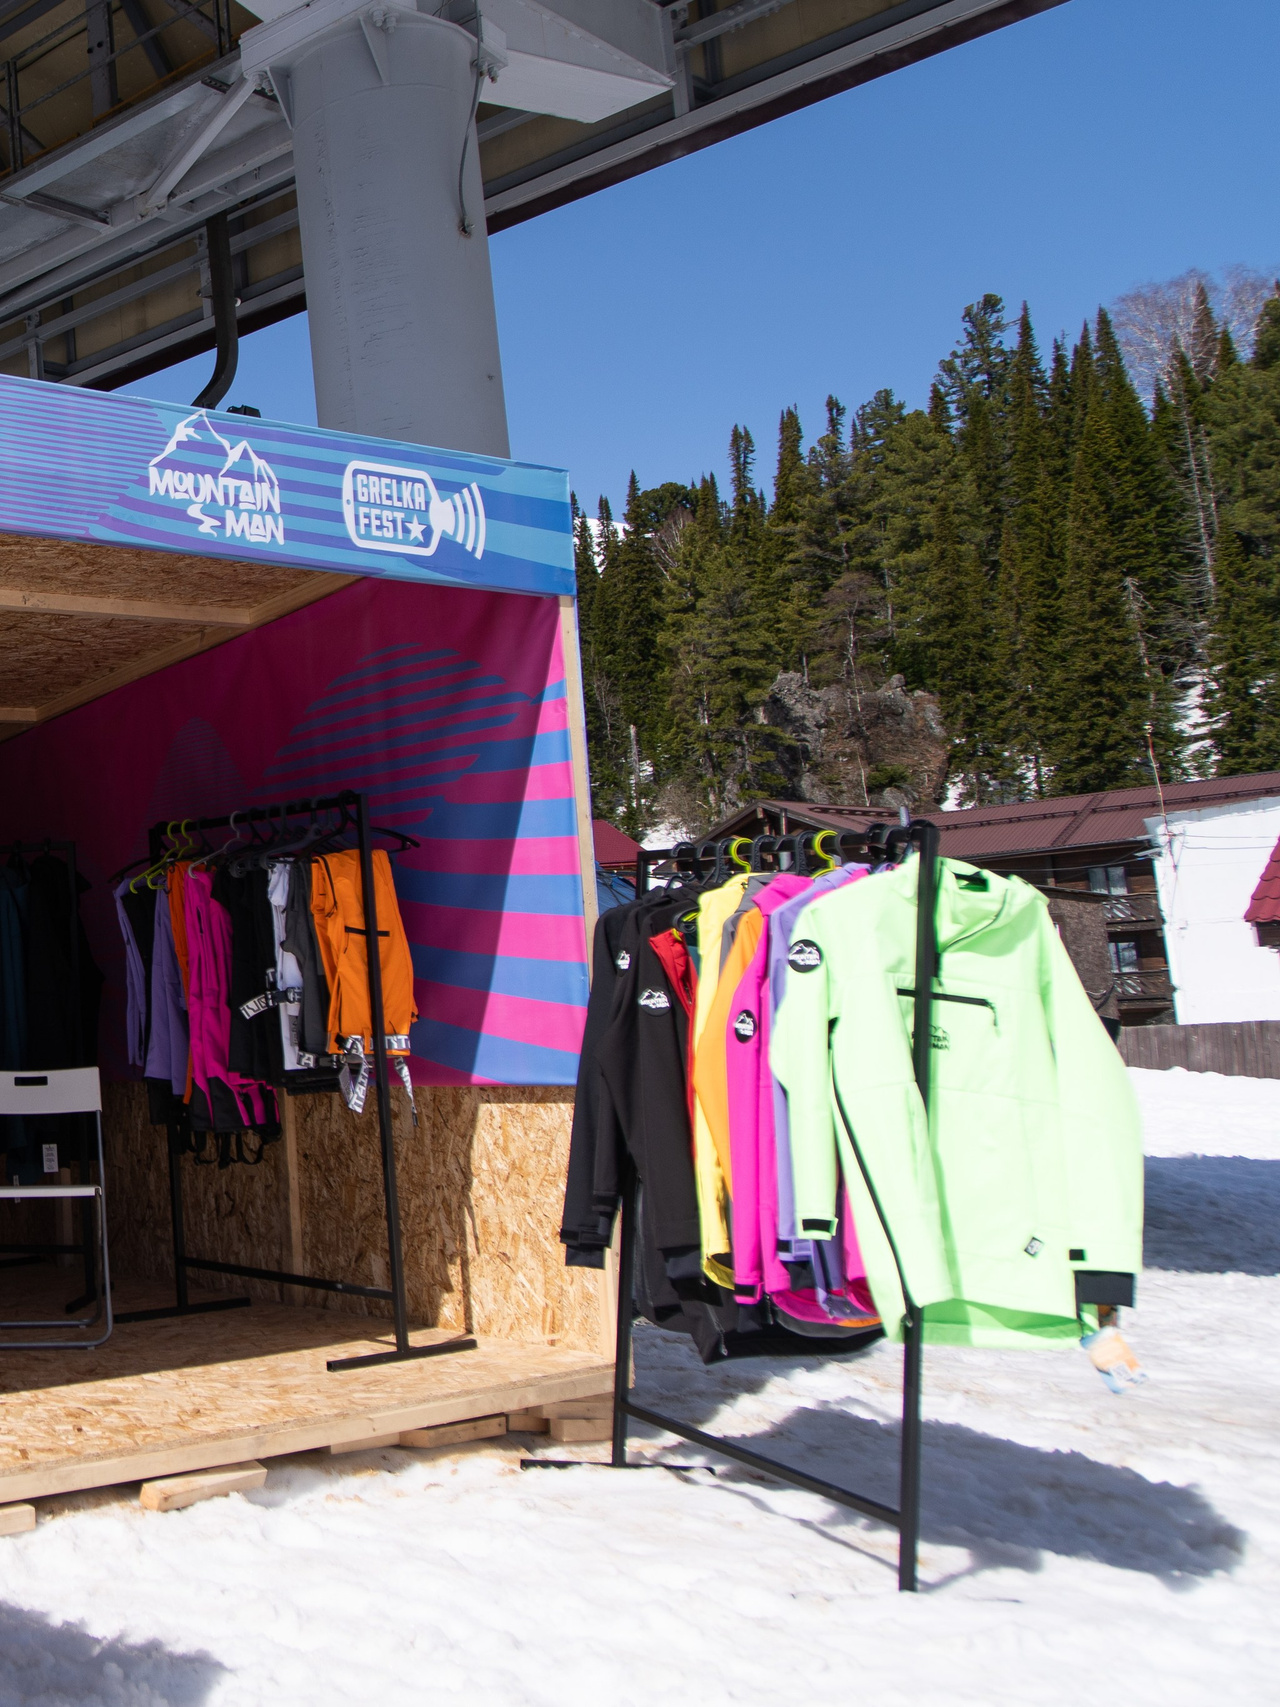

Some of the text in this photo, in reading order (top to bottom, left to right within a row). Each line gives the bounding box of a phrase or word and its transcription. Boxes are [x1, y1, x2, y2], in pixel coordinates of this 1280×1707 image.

[149, 465, 281, 514] MOUNTAIN
[356, 472, 425, 511] GRELKA
[225, 508, 285, 546] MAN
[358, 506, 405, 540] FEST
